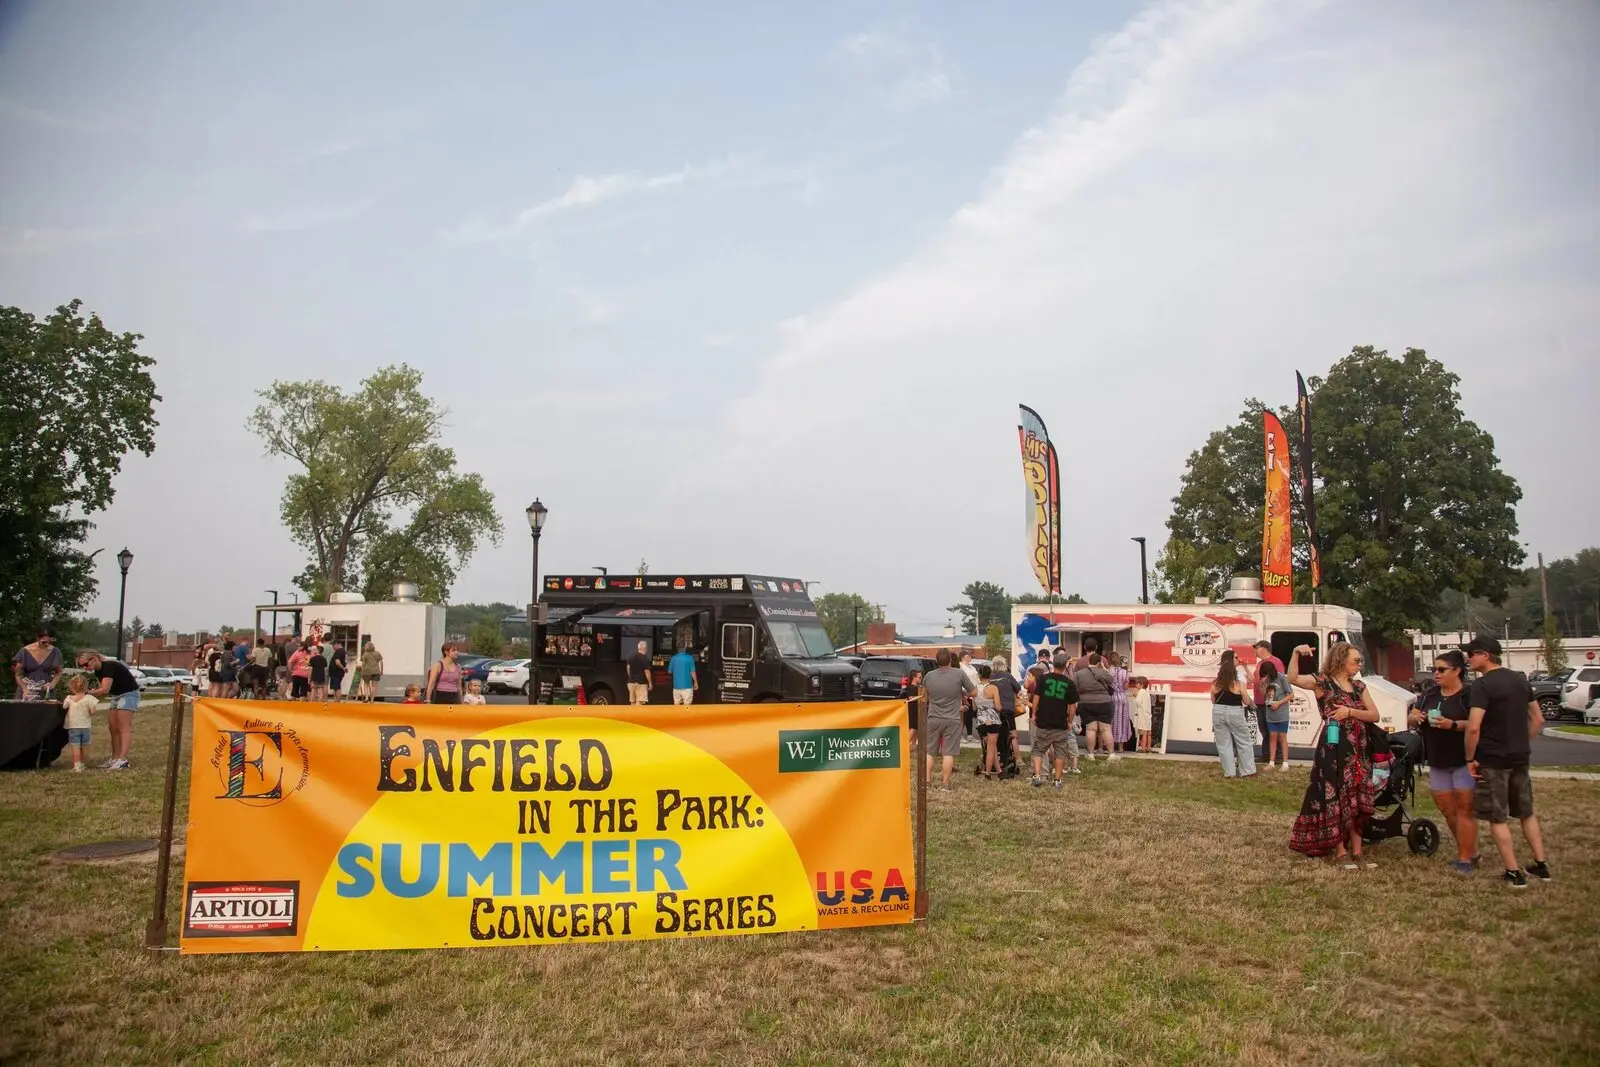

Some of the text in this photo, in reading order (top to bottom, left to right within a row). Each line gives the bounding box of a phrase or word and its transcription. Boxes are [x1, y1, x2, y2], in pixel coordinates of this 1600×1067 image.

[1044, 678, 1069, 700] 35
[244, 719, 273, 729] Culture
[274, 722, 284, 731] &
[283, 729, 302, 746] Arts
[828, 737, 890, 748] WINSTANLEY
[211, 735, 228, 768] Enfield
[377, 725, 613, 792] ENFIELD
[786, 741, 816, 759] WE
[828, 749, 891, 761] ENTERPRISES
[518, 789, 764, 834] IN THE PARK:
[336, 838, 688, 899] SUMMER
[817, 868, 909, 906] USA
[191, 899, 292, 917] ARTIOLI
[469, 892, 776, 941] CONCERT SERIES
[818, 902, 910, 916] WASTE & RECYCLING
